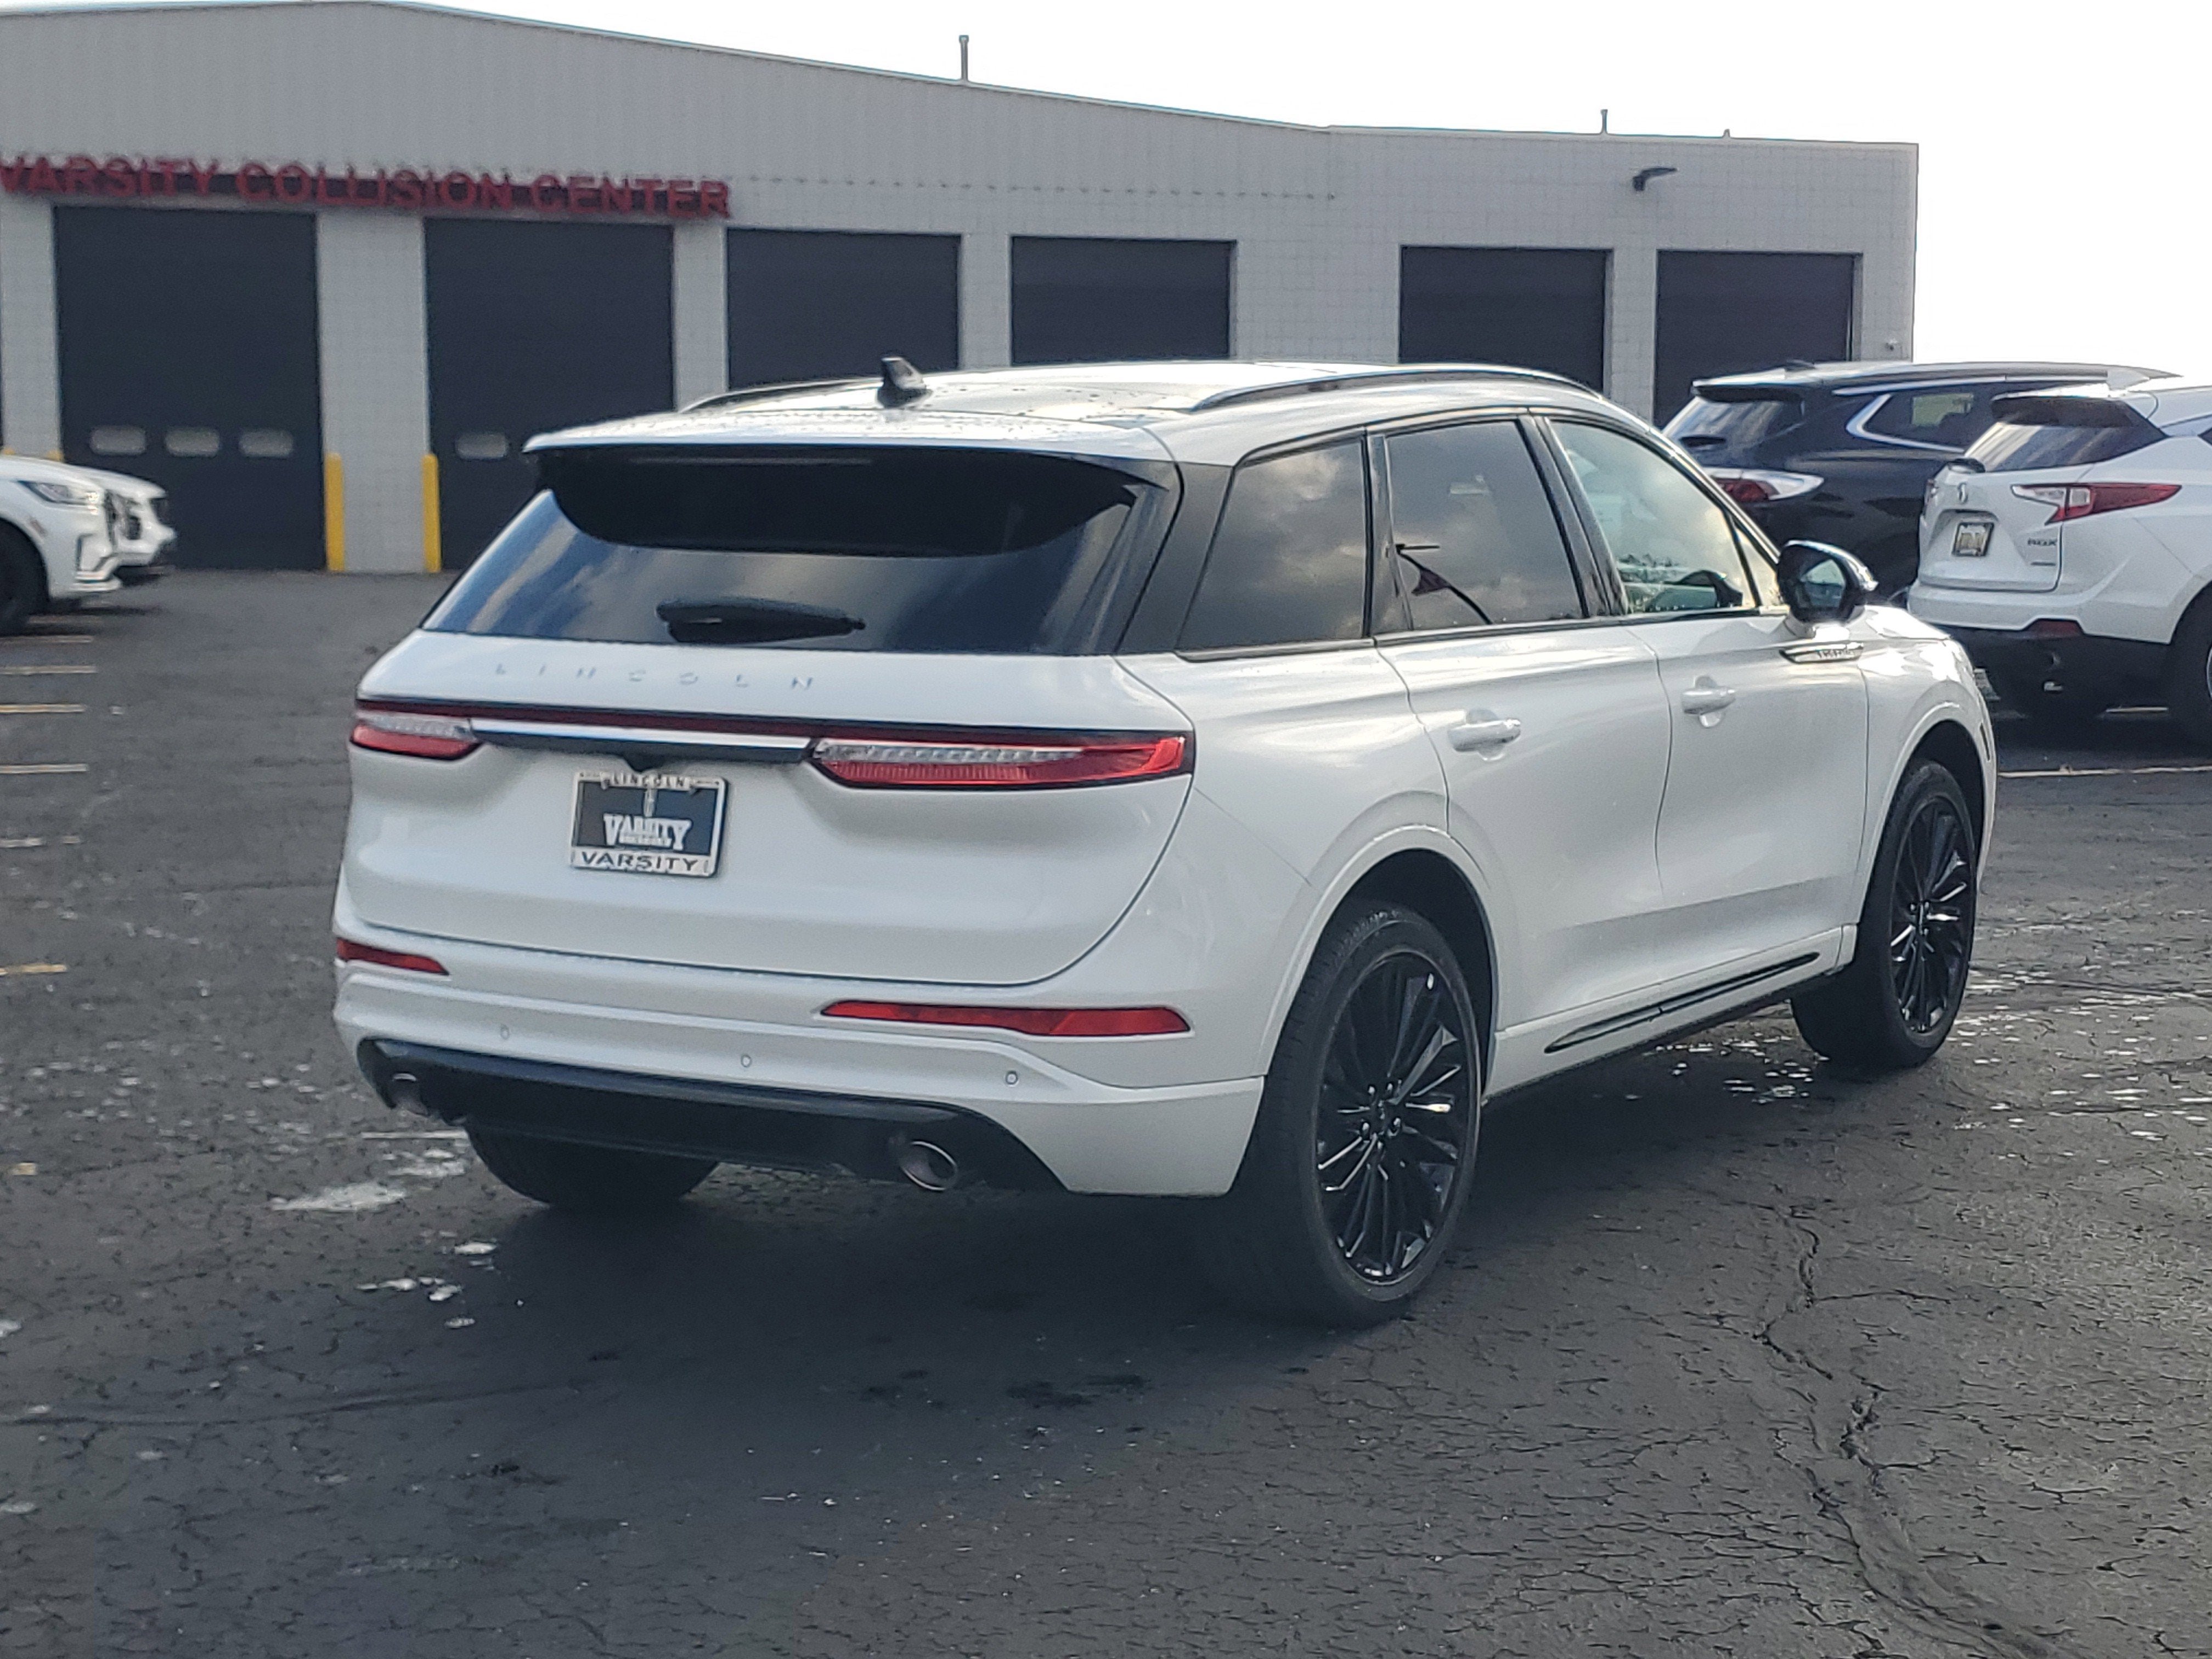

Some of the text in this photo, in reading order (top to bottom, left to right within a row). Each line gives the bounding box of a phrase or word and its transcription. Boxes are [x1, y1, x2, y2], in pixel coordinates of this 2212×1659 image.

[0, 155, 730, 218] VARSITY COLLISION CENTER
[495, 662, 814, 690] LINCOLN
[582, 851, 699, 871] VARSITY
